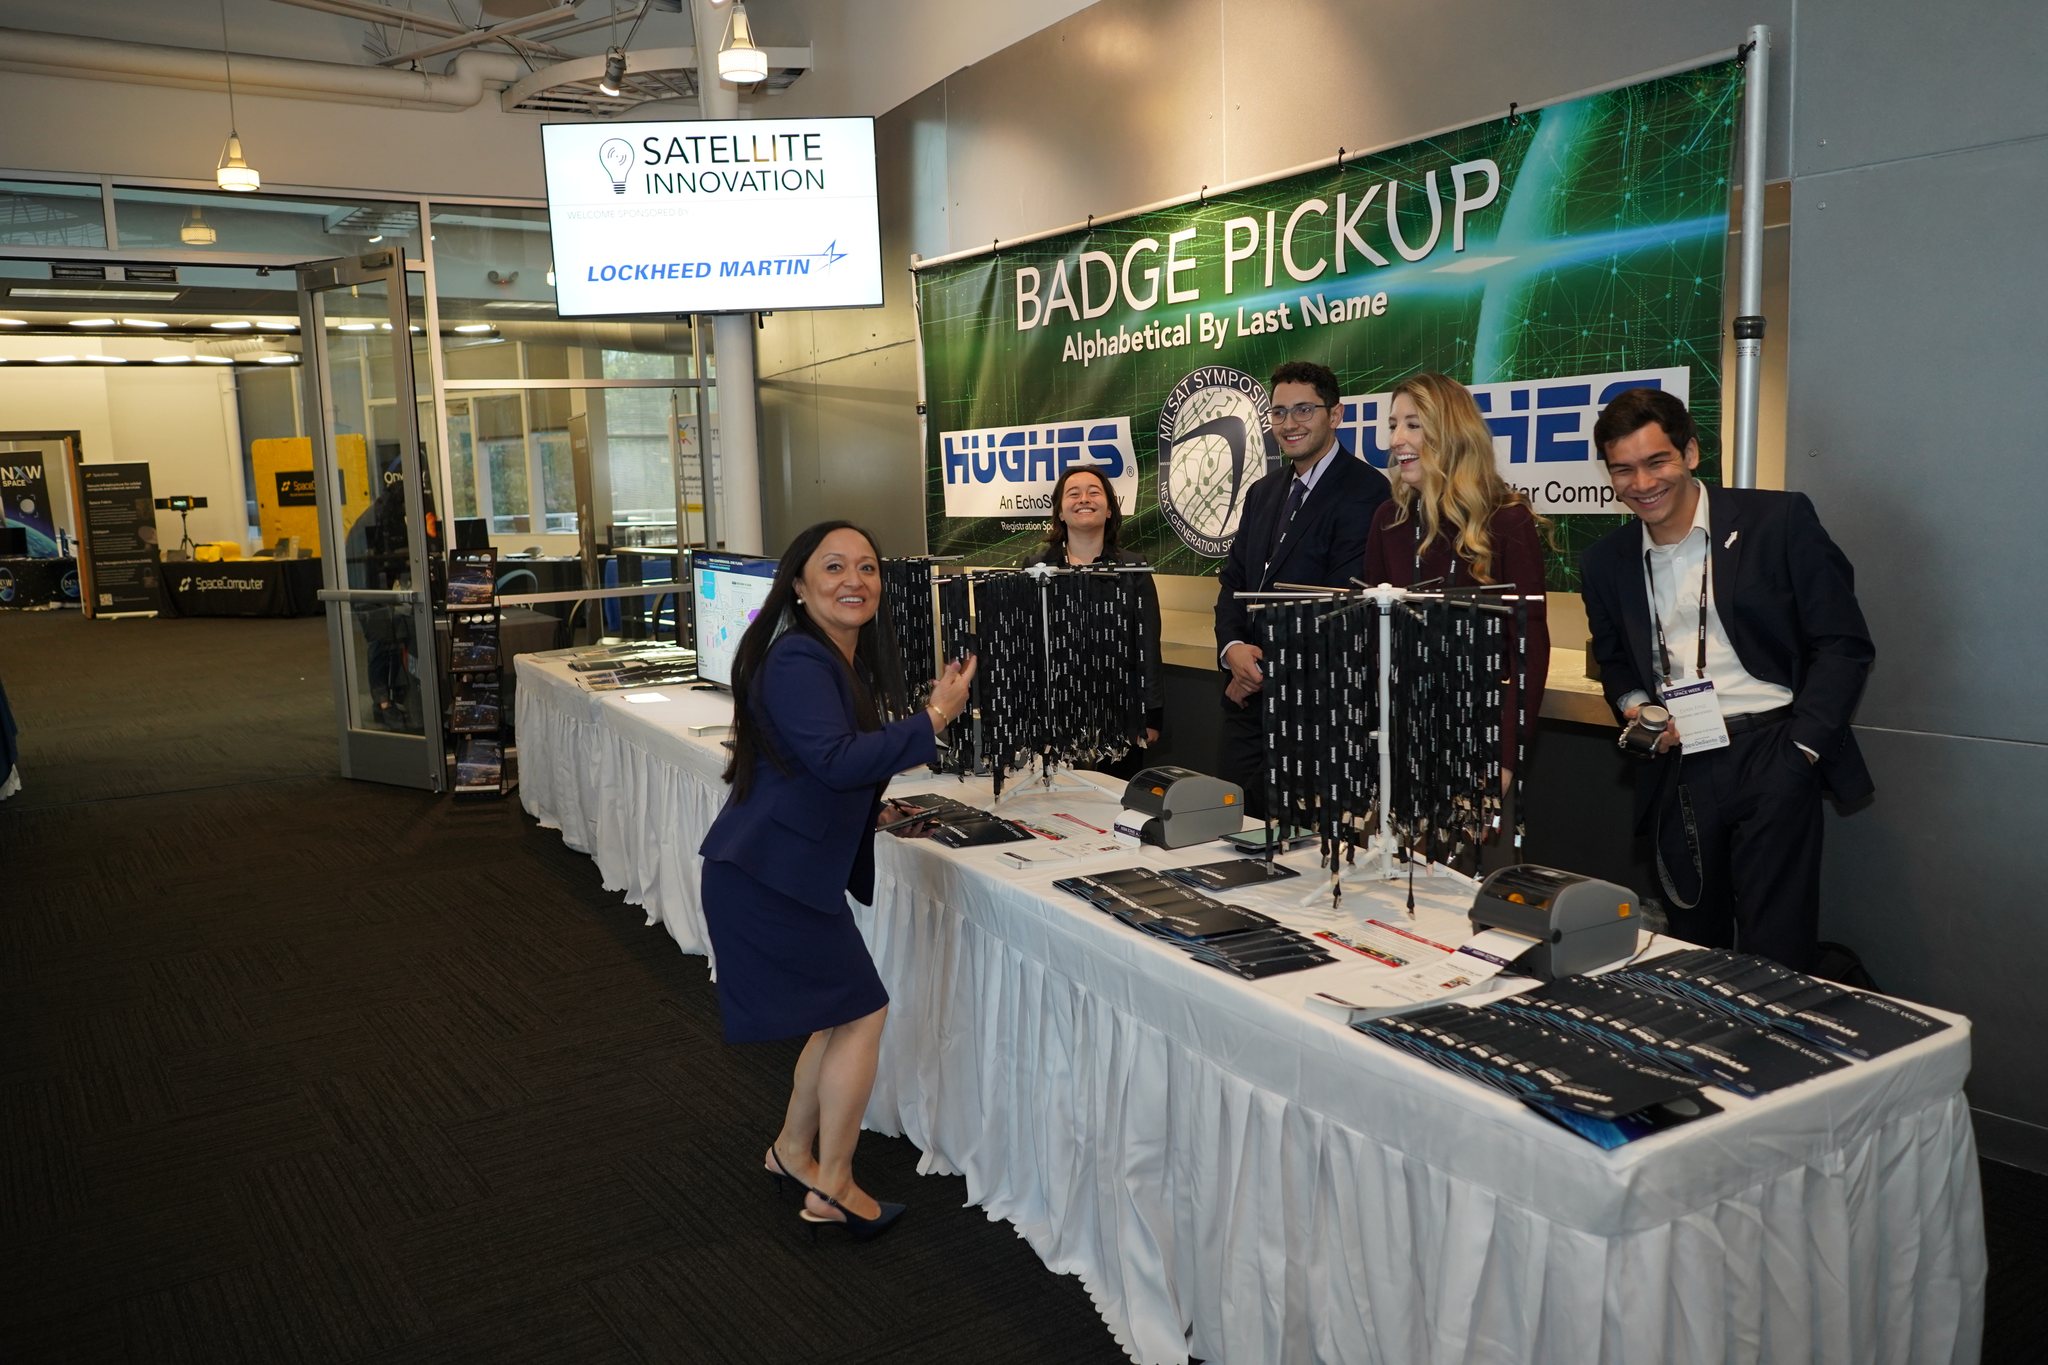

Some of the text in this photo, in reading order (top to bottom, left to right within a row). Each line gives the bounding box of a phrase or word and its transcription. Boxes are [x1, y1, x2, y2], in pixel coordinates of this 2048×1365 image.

[643, 133, 823, 166] SATELLITE
[646, 169, 825, 195] INNOVATION
[567, 209, 615, 220] WELCOME
[618, 207, 677, 218] SPONSORED
[1016, 158, 1500, 331] BADGE PICKUP
[587, 258, 810, 282] LOCKHEED MARTIN
[1062, 291, 1388, 367] Alphabetical By Last Name
[1159, 368, 1273, 442] MILSAT SYMPOSIUM
[944, 424, 1124, 484] HUGHES
[0, 465, 42, 482] NXW
[2, 479, 27, 488] SPACE
[999, 495, 1013, 510] An
[1545, 480, 1623, 508] Comp
[1000, 520, 1042, 533] Registration
[1160, 481, 1221, 553] NEXT-GENERATION
[195, 576, 264, 592] SpaceComputer
[1900, 1010, 1933, 1028] WEEK
